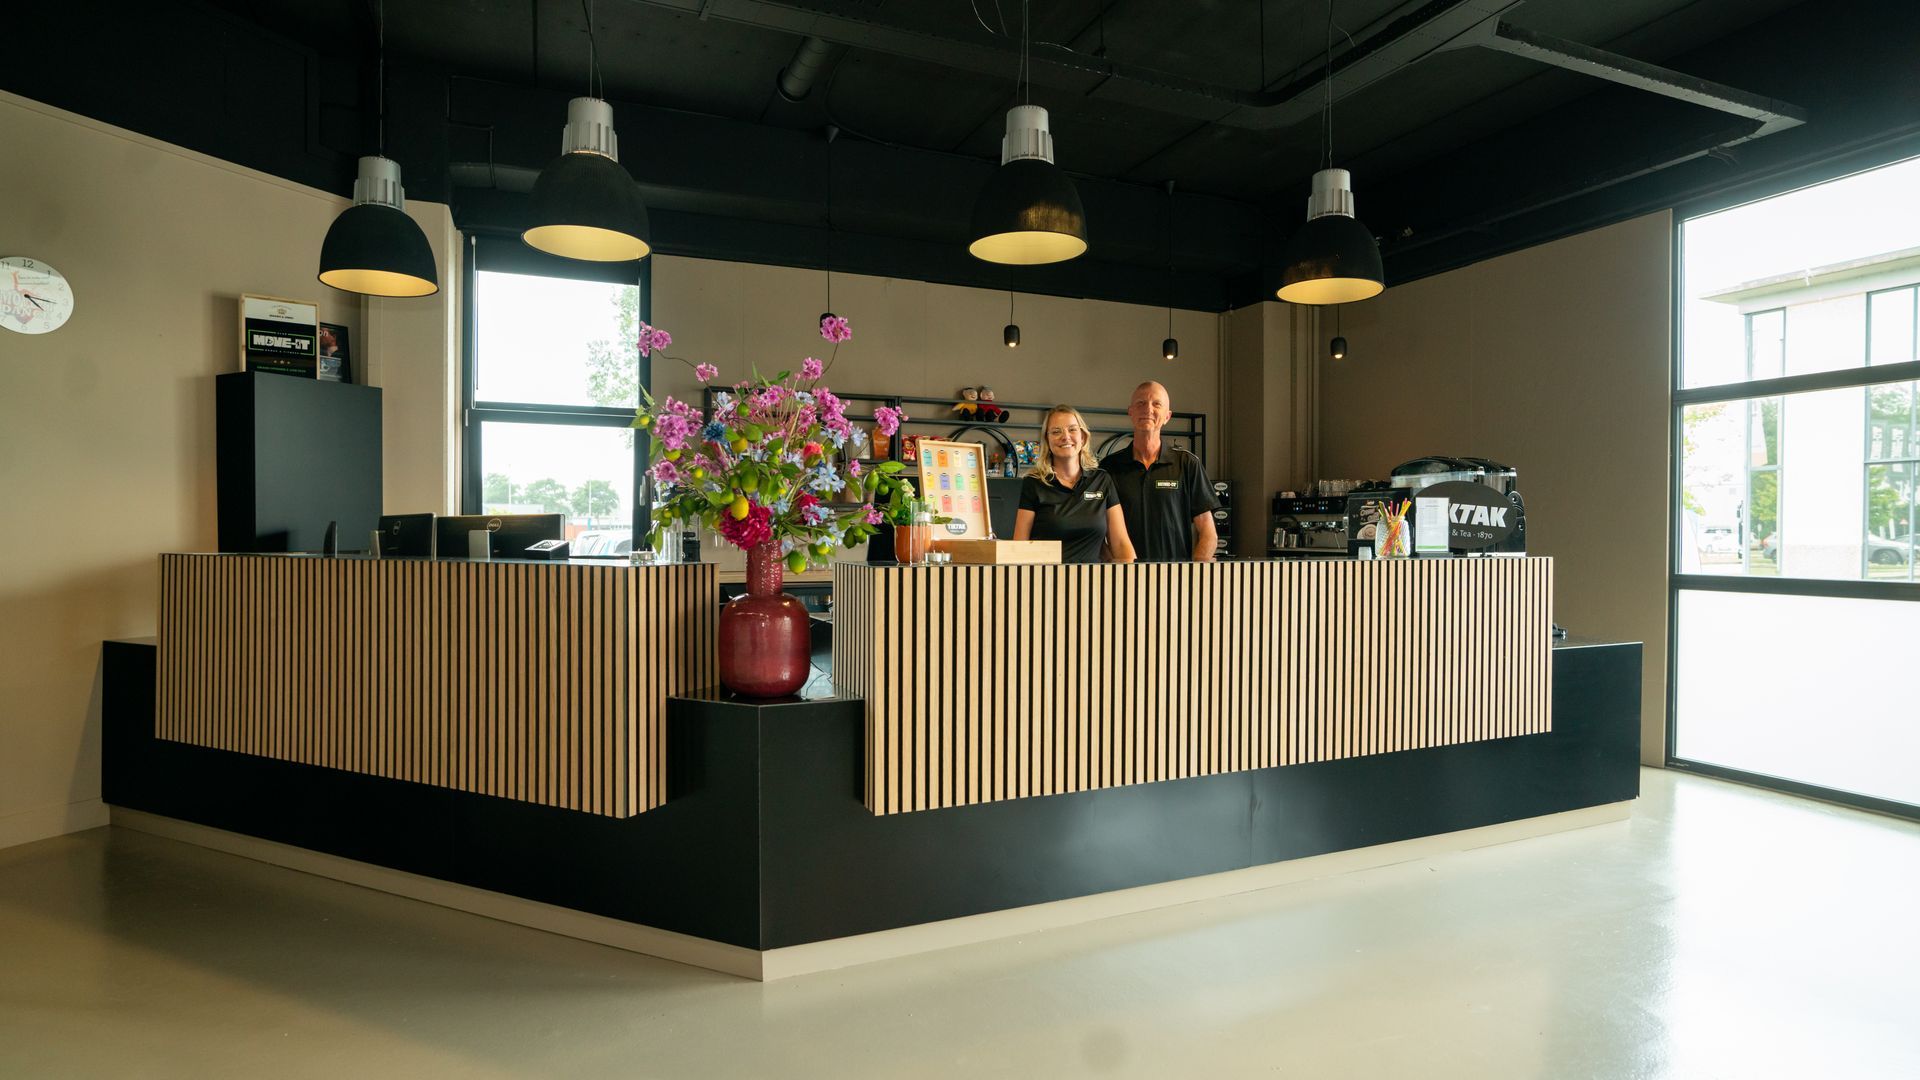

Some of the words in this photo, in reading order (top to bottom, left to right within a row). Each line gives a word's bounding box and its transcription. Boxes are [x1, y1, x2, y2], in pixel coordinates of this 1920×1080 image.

[23, 259, 34, 269] 12
[253, 334, 310, 350] MOVE-IT
[1460, 529, 1472, 537] Tea
[1477, 532, 1493, 540] 1870
